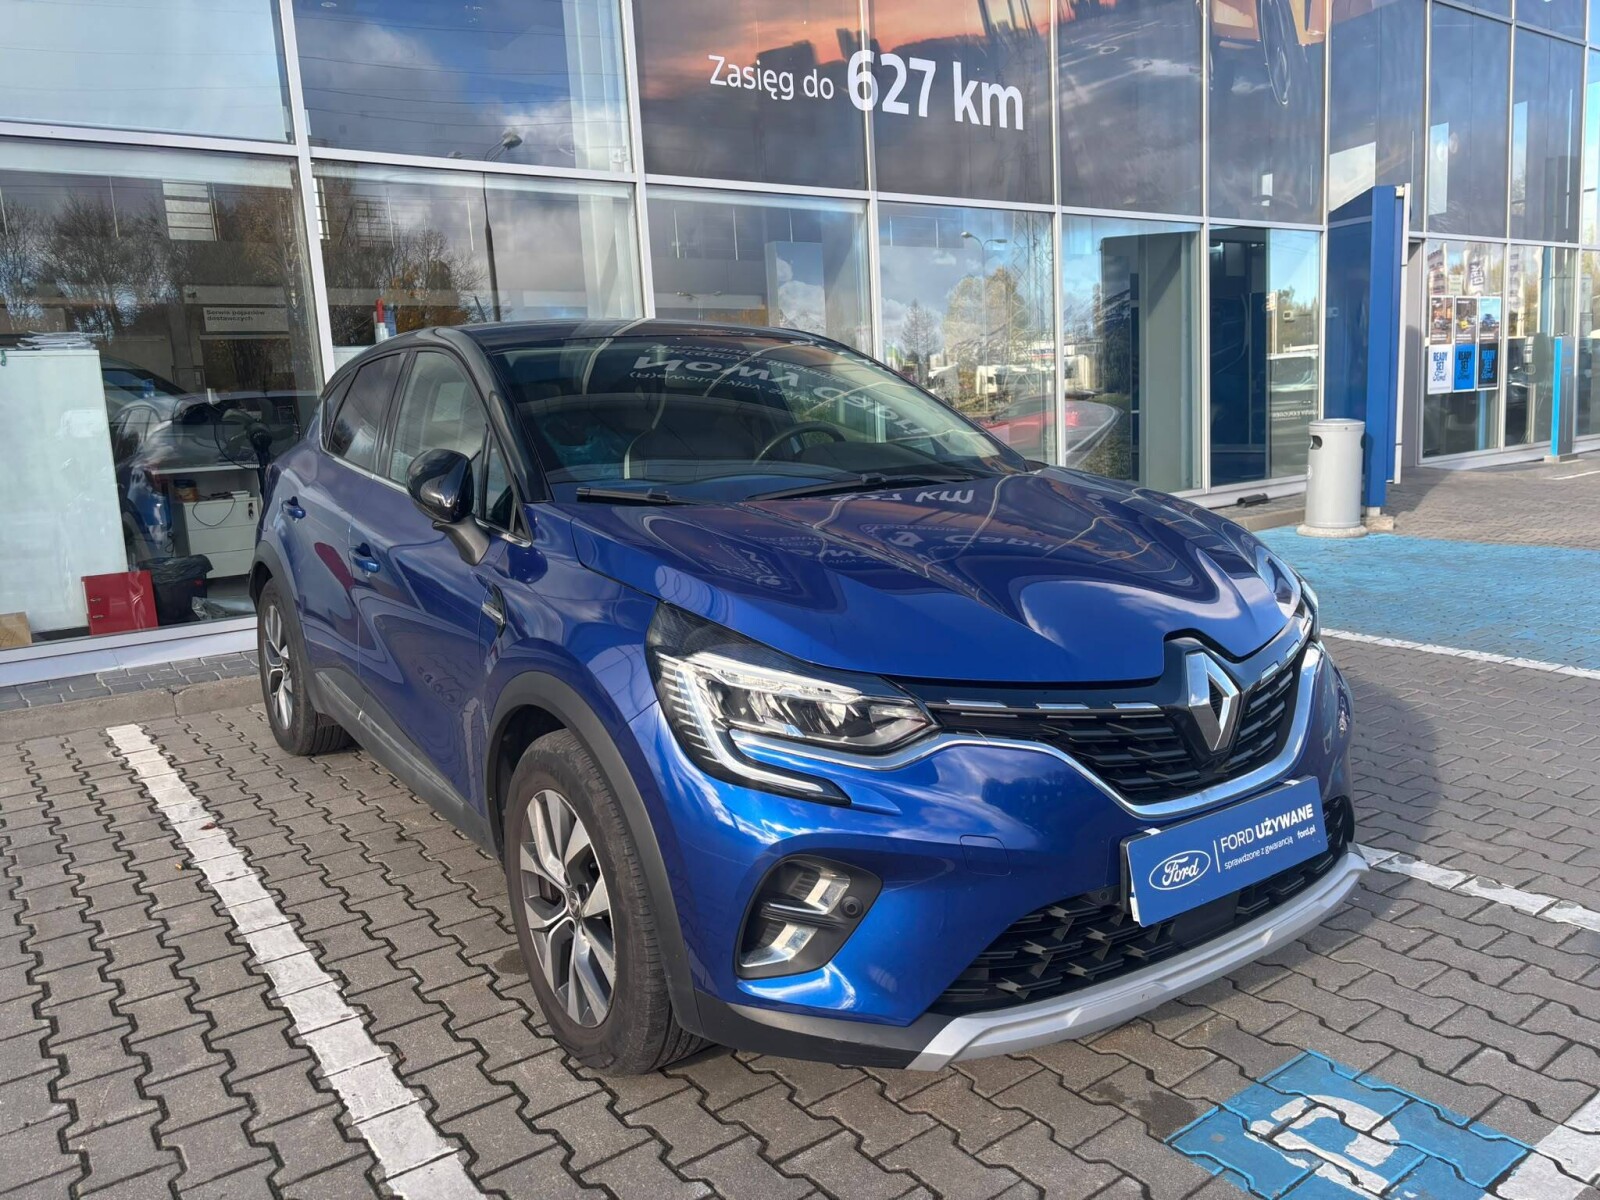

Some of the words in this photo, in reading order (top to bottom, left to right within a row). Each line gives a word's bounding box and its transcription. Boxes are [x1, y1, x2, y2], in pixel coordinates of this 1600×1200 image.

[708, 55, 795, 101] Zasięg
[802, 69, 835, 100] do
[847, 49, 937, 118] 627
[952, 61, 1024, 131] km
[1220, 827, 1255, 853] FORD
[1255, 803, 1314, 839] UŻYWANE
[1224, 849, 1260, 870] sprawdzone
[1264, 836, 1294, 855] gwarancją
[1296, 824, 1316, 839] ford.pl
[1161, 855, 1200, 887] Ford
